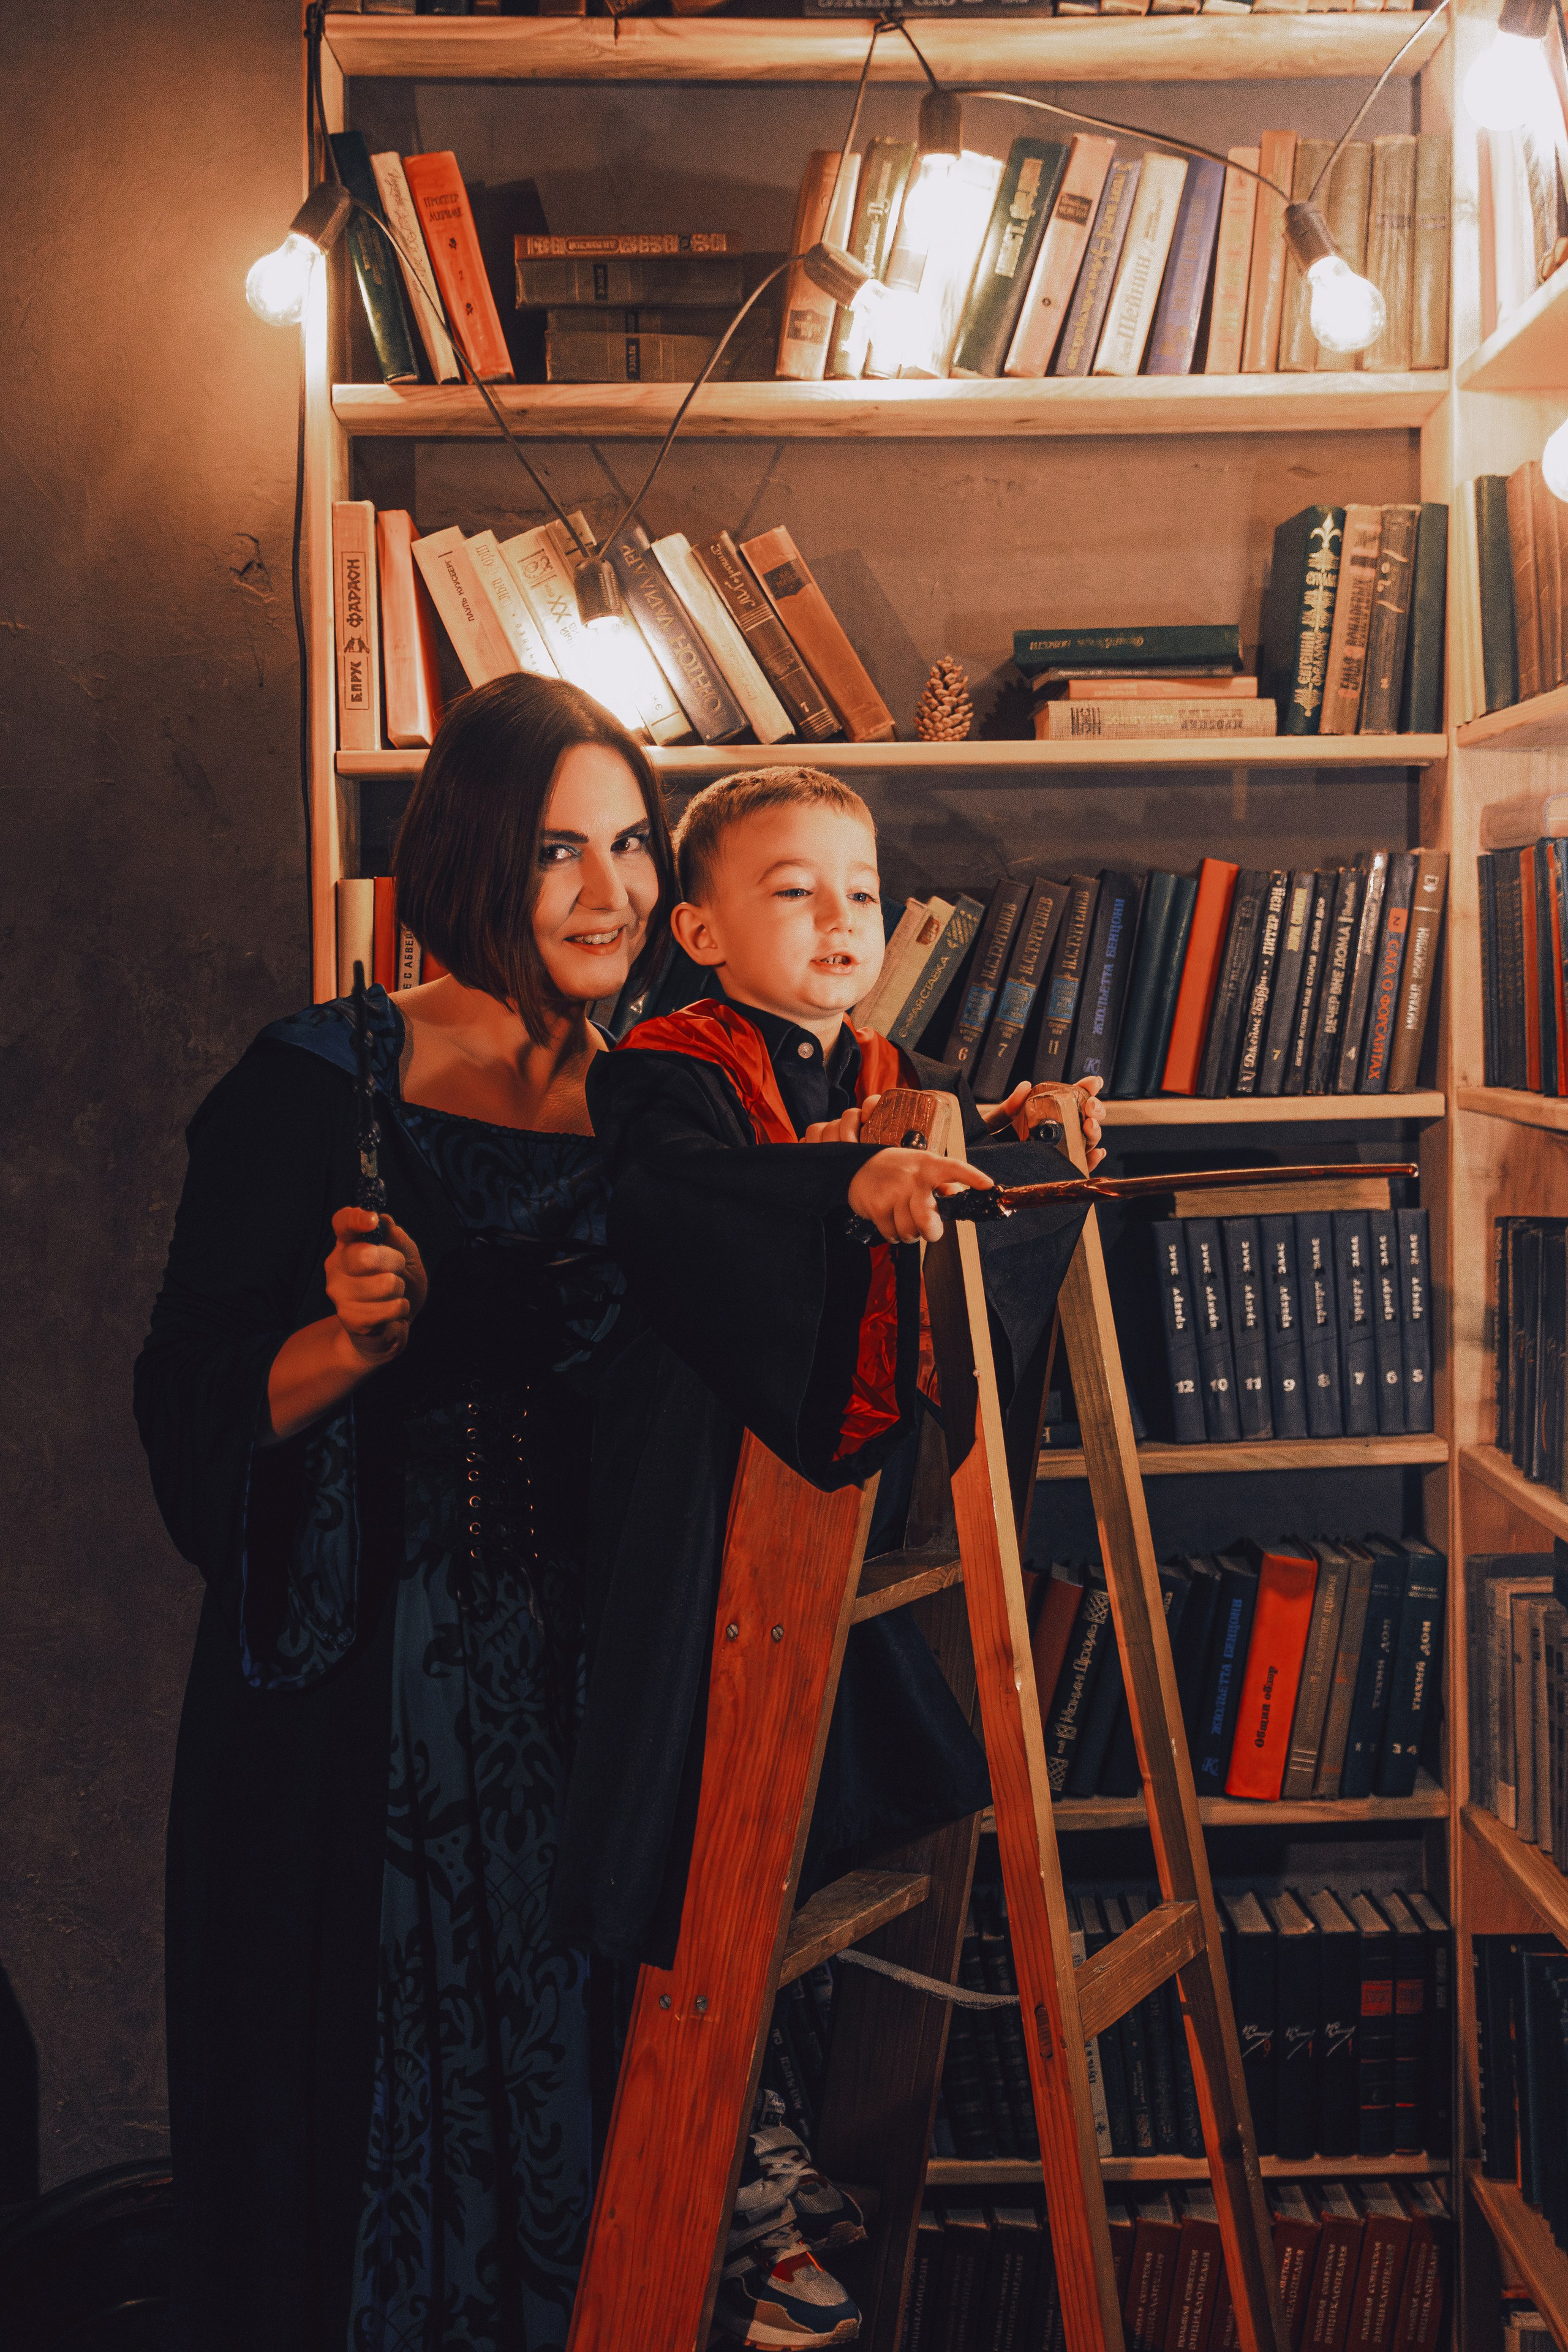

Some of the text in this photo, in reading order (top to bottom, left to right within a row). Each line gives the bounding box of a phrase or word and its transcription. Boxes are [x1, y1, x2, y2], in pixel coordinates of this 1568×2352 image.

[423, 193, 459, 208] ПРОСПЕР
[458, 270, 465, 281] 2
[1117, 255, 1153, 339] Шейнин
[347, 558, 363, 628] ФАРАОН
[445, 557, 475, 622] ПАУЛЬ КУУСБЕРГ
[492, 576, 514, 610] Ольга
[1270, 887, 1286, 914] ПЭН
[1262, 913, 1280, 956] ПИТЕР
[1092, 899, 1126, 1036] ЖЮЛЬЕТТА БЕНЦОНИ
[1383, 940, 1400, 978] САГА
[921, 956, 949, 1000] СТАВКА
[1306, 955, 1317, 987] СТАРЫЙ
[1324, 925, 1351, 1035] ВЕЧЕР ВНЕ ДОМА
[1382, 979, 1394, 991] О
[997, 1042, 1008, 1058] 7
[1244, 1016, 1261, 1068] Джеймс
[958, 1048, 968, 1061] 6
[1272, 1049, 1281, 1061] 7
[1347, 1047, 1355, 1060] 4
[1175, 1379, 1194, 1393] 12
[1210, 1378, 1229, 1392] 10
[1245, 1376, 1262, 1390] 11
[1283, 1379, 1296, 1392] 9
[1317, 1373, 1331, 1387] 8
[1354, 1371, 1365, 1385] 7
[1385, 1370, 1398, 1384] 6
[1411, 1369, 1424, 1382] 5
[1211, 1597, 1243, 1735] ЖЮЛЬЕТТА БЕНЦОНИ
[1411, 1621, 1432, 1712] ТИХИЙ ДОН
[1262, 1665, 1279, 1700] обзор
